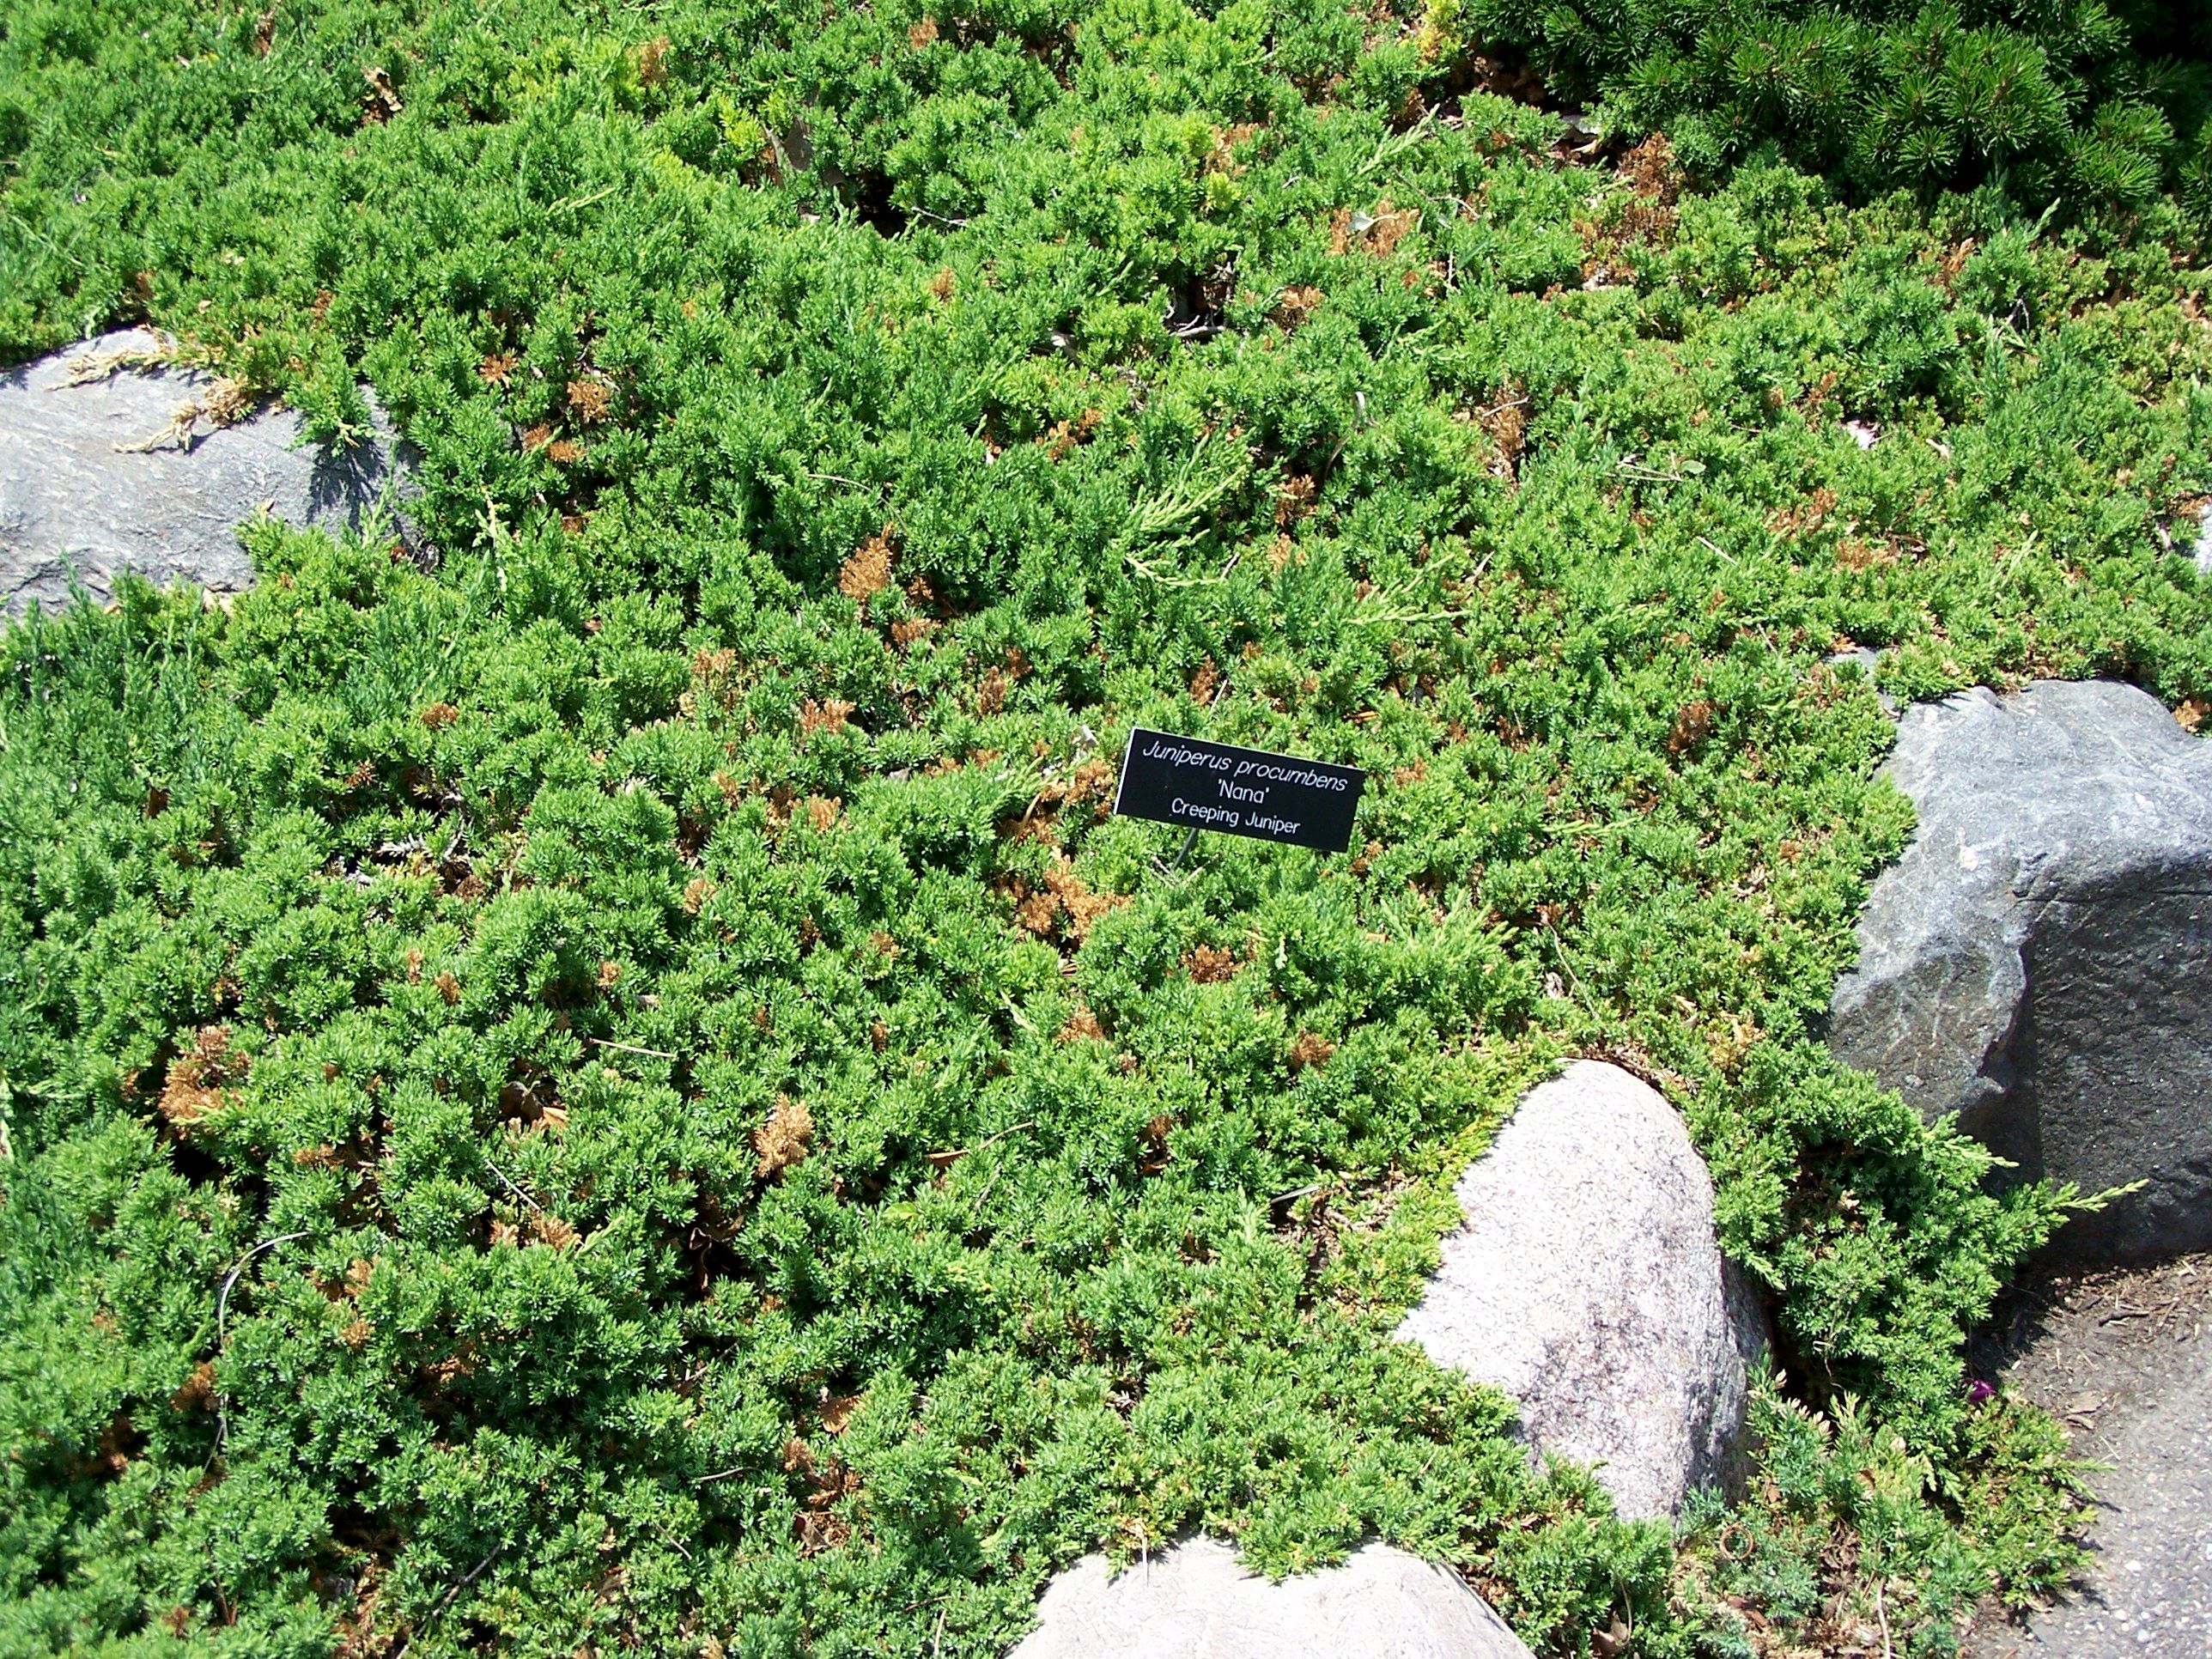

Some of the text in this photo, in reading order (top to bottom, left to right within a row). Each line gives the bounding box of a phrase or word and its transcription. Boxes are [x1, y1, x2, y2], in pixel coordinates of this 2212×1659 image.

[1142, 740, 1348, 792] Juniperus procumbens
[1218, 780, 1270, 805] 'Nana'
[1171, 798, 1301, 836] Creeping Juniper
